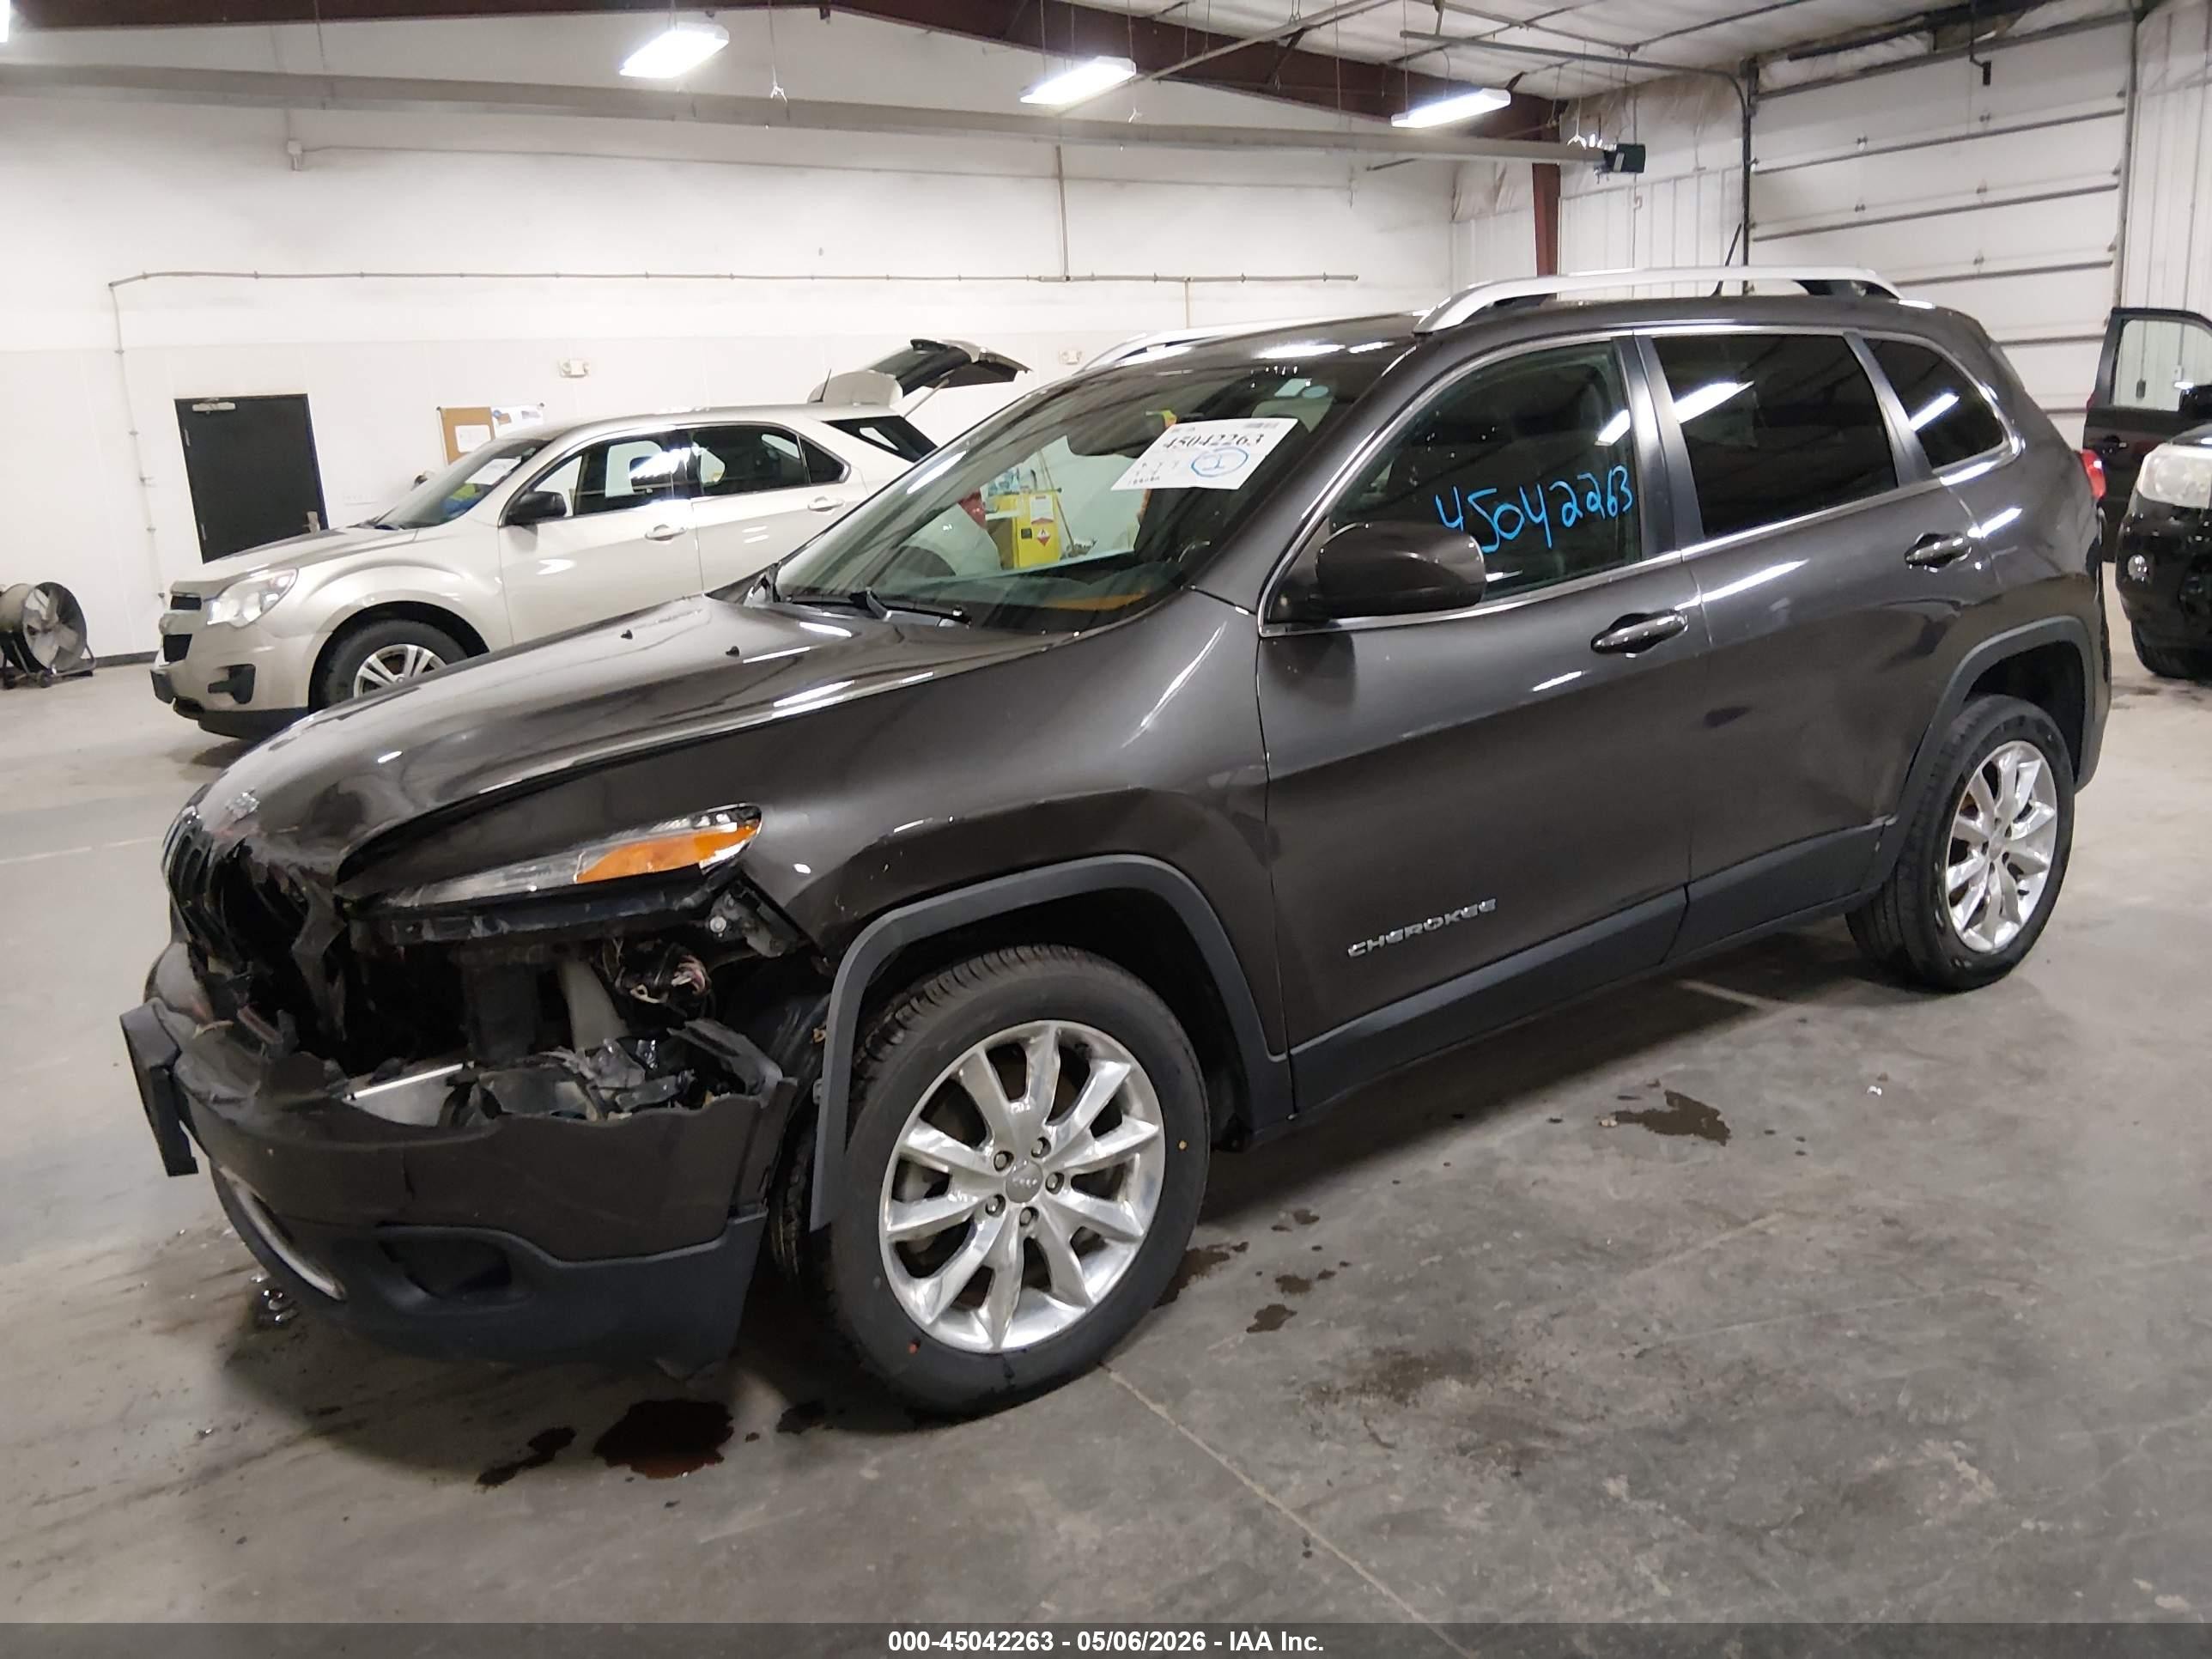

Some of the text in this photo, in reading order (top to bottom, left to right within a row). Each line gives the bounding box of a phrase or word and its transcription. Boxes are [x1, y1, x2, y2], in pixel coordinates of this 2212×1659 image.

[1163, 433, 1265, 450] 45042263
[1435, 465, 1633, 554] 45042263
[1347, 898, 1497, 957] CHEROKEE
